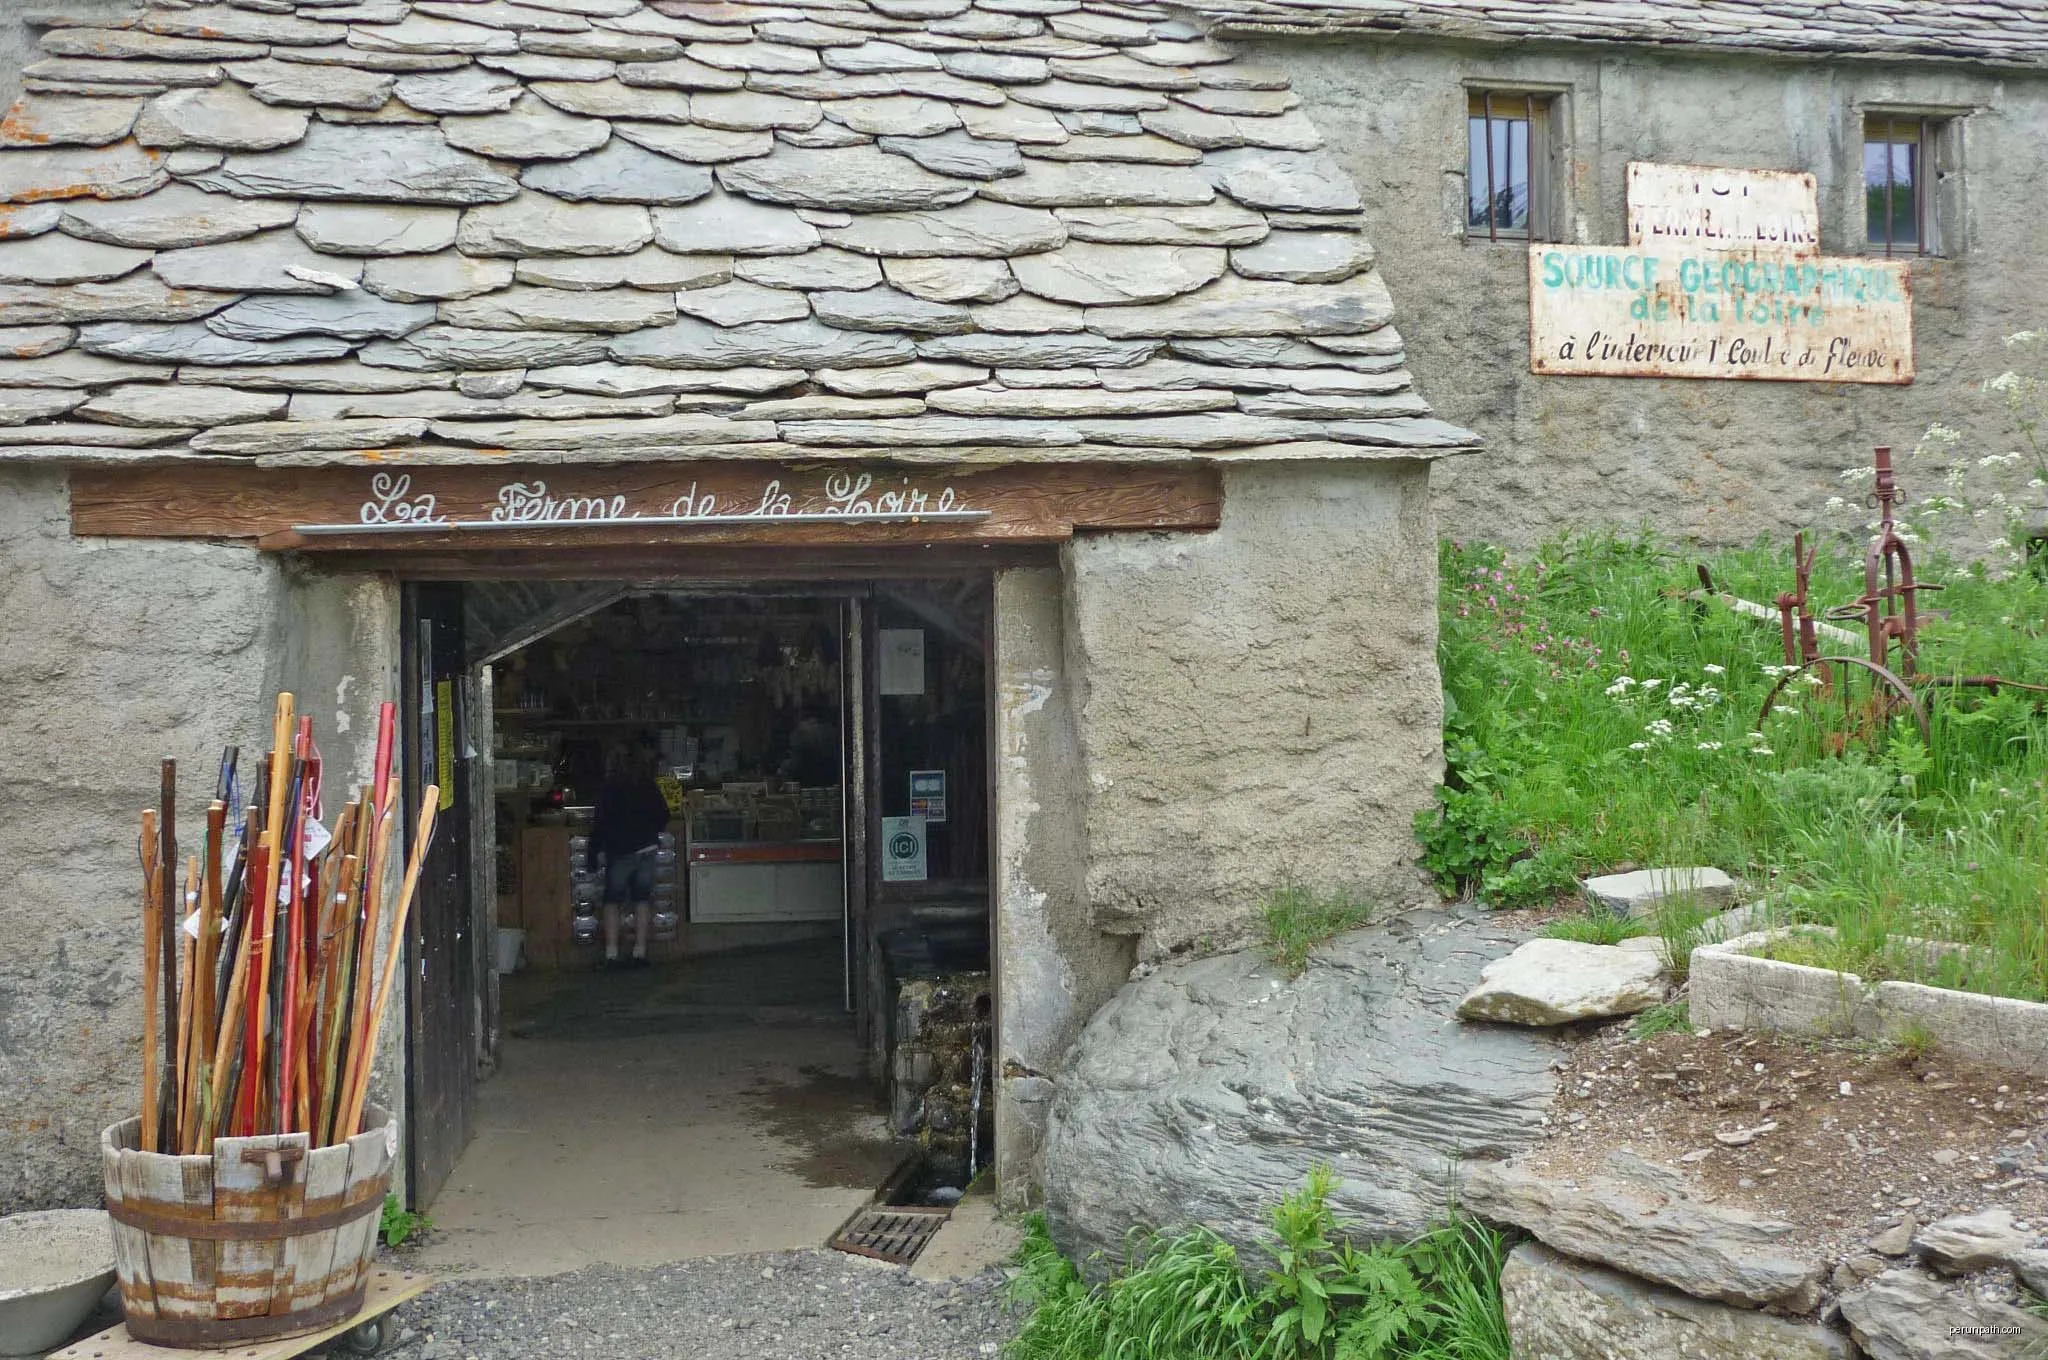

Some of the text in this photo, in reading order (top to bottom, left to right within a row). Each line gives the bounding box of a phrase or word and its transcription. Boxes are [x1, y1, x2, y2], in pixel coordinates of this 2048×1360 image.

[1631, 293, 1668, 321] de
[1687, 294, 1719, 322] la
[1559, 336, 1576, 360] à
[360, 473, 967, 524] La Ferme de la Loire
